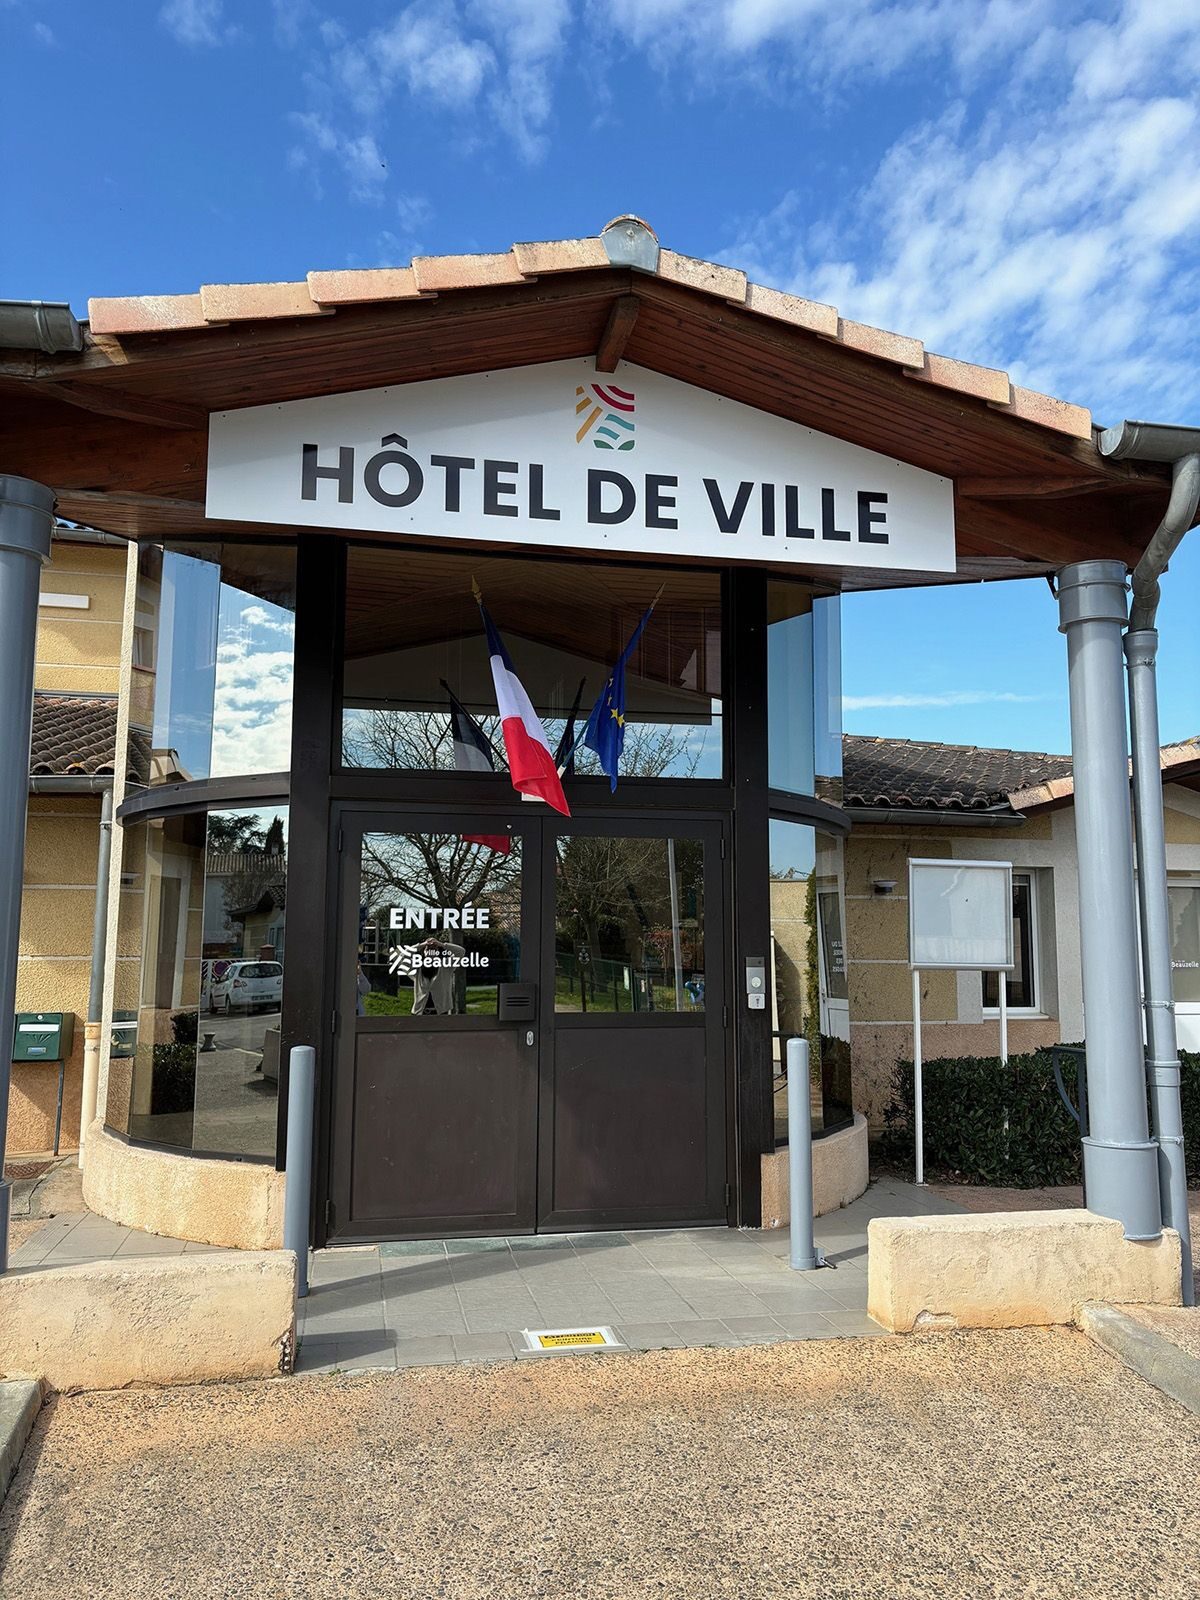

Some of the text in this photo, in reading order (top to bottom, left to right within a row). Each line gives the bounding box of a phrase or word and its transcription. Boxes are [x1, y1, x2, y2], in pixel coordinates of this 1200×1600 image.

[301, 432, 890, 545] HÔTEL DE VILLE
[389, 901, 490, 929] ENTRÉE
[411, 952, 490, 968] Beauzelle
